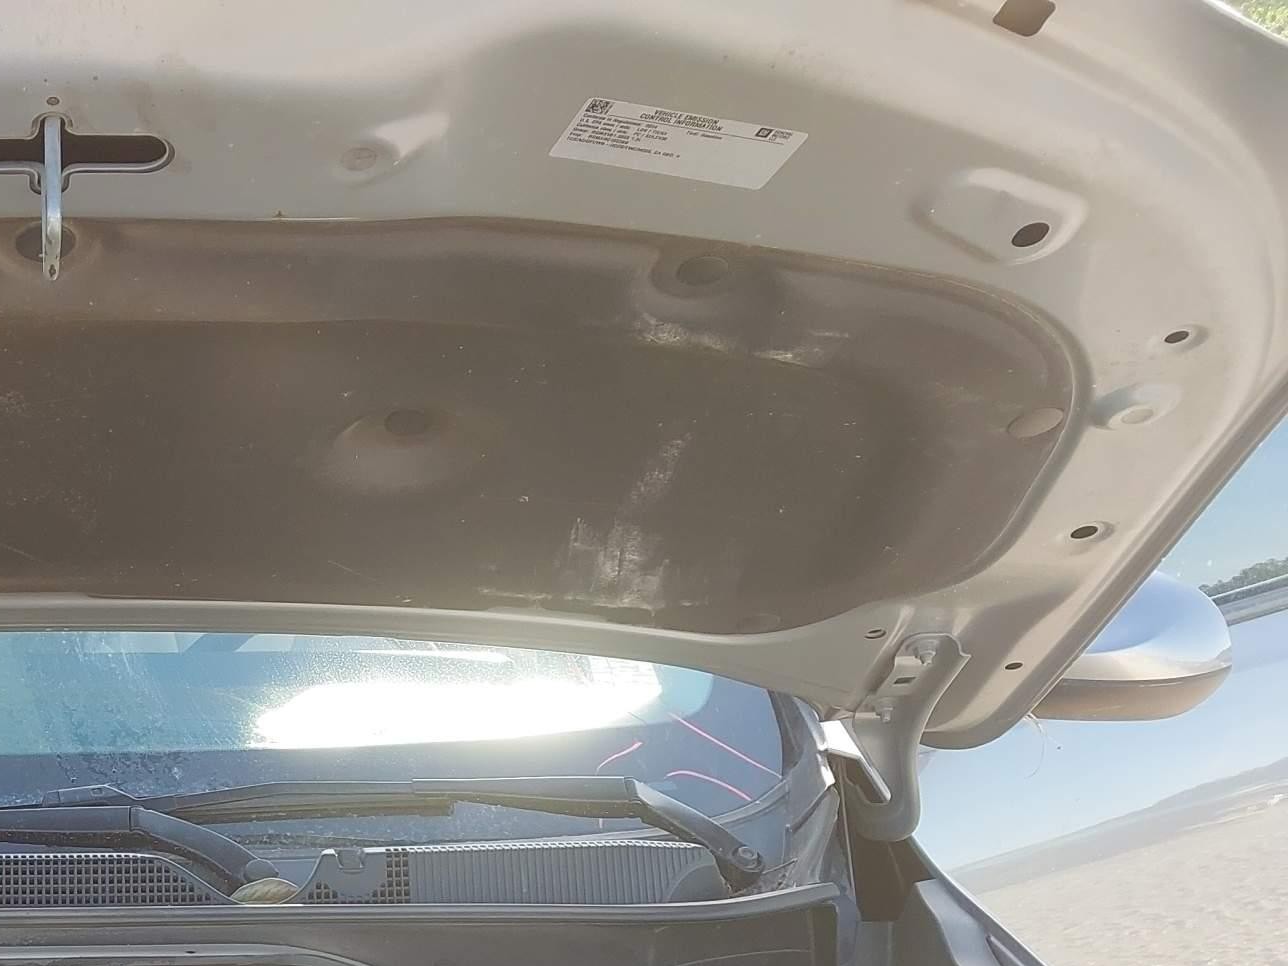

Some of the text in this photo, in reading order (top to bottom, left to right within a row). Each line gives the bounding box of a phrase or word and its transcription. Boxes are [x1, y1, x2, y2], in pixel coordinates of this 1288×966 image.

[639, 112, 672, 124] CONTROL
[673, 119, 723, 132] INFORMATION
[654, 109, 720, 125] VEHICLE EMISSION
